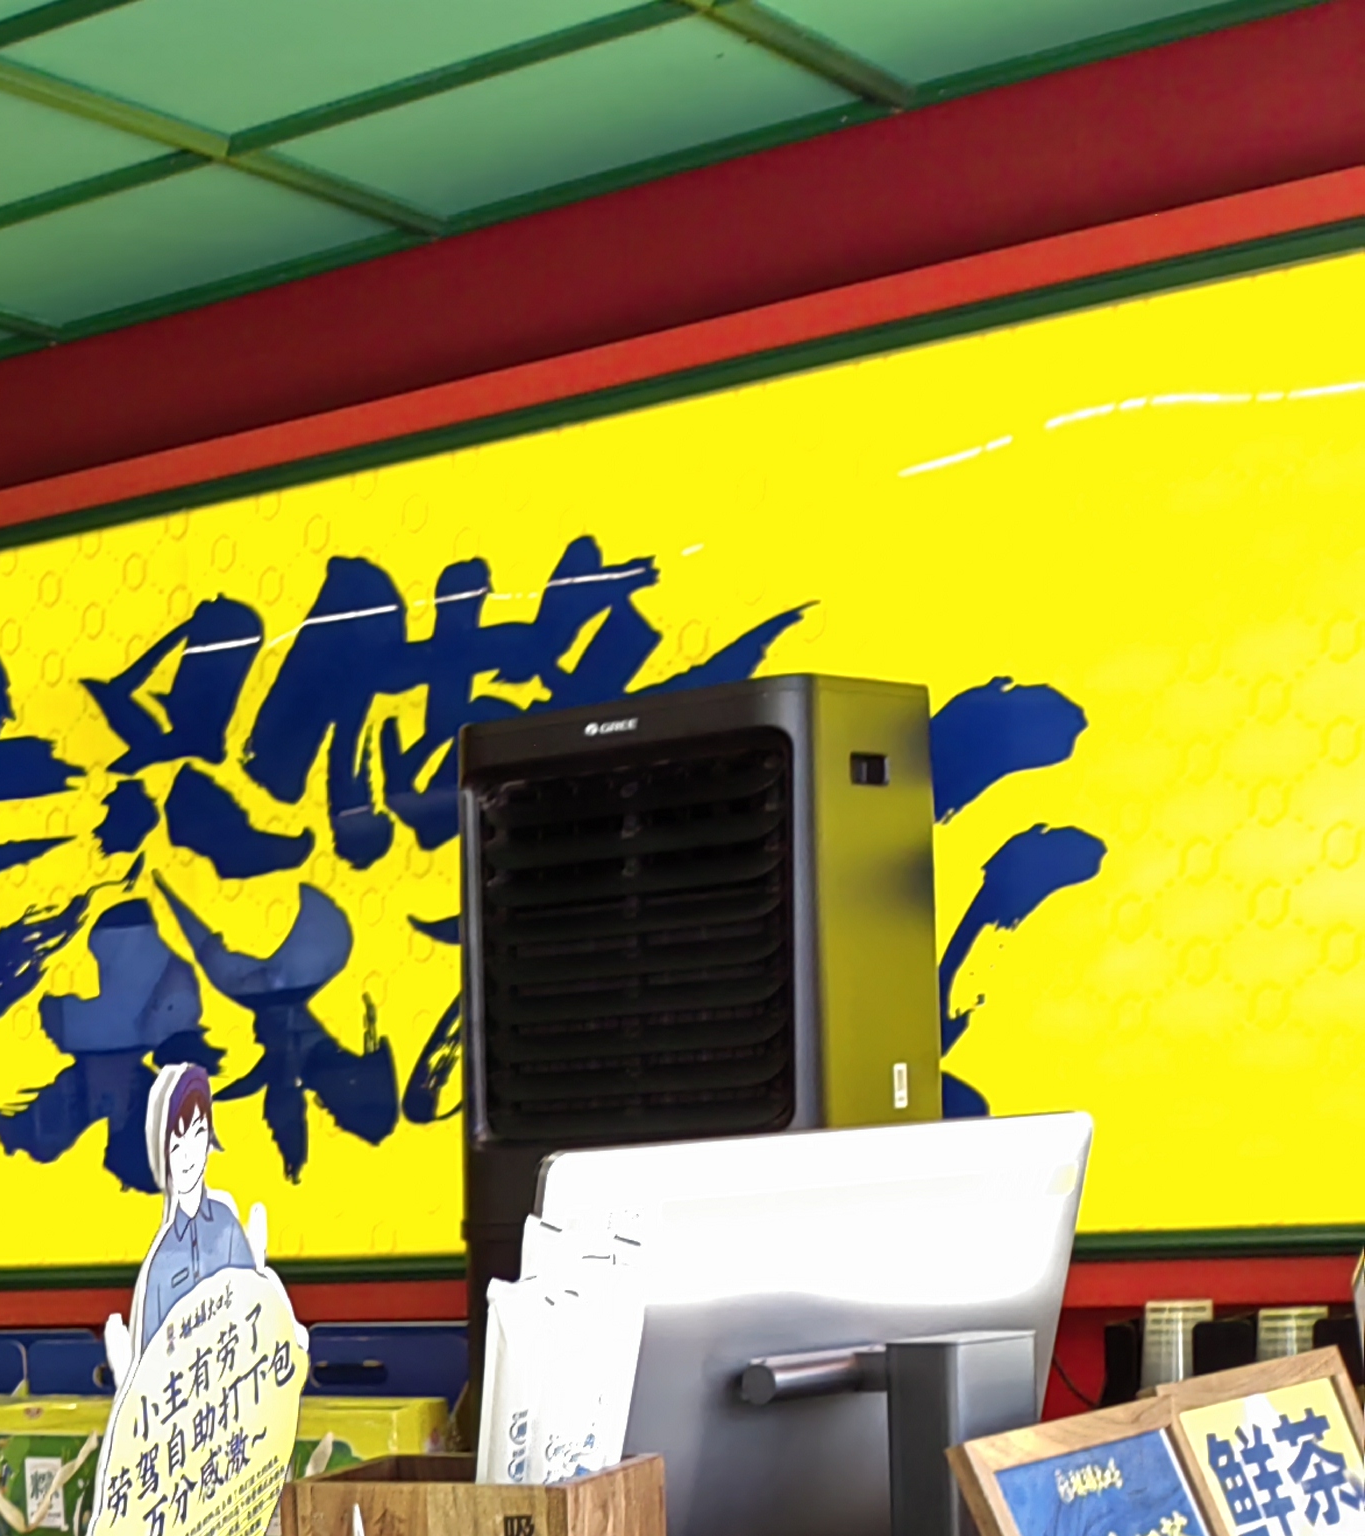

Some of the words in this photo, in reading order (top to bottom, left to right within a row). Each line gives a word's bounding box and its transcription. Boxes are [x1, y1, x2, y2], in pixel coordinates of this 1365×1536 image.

[108, 1339, 296, 1529] 劳驾自助打下包
[133, 1303, 262, 1441] 小主有劳了
